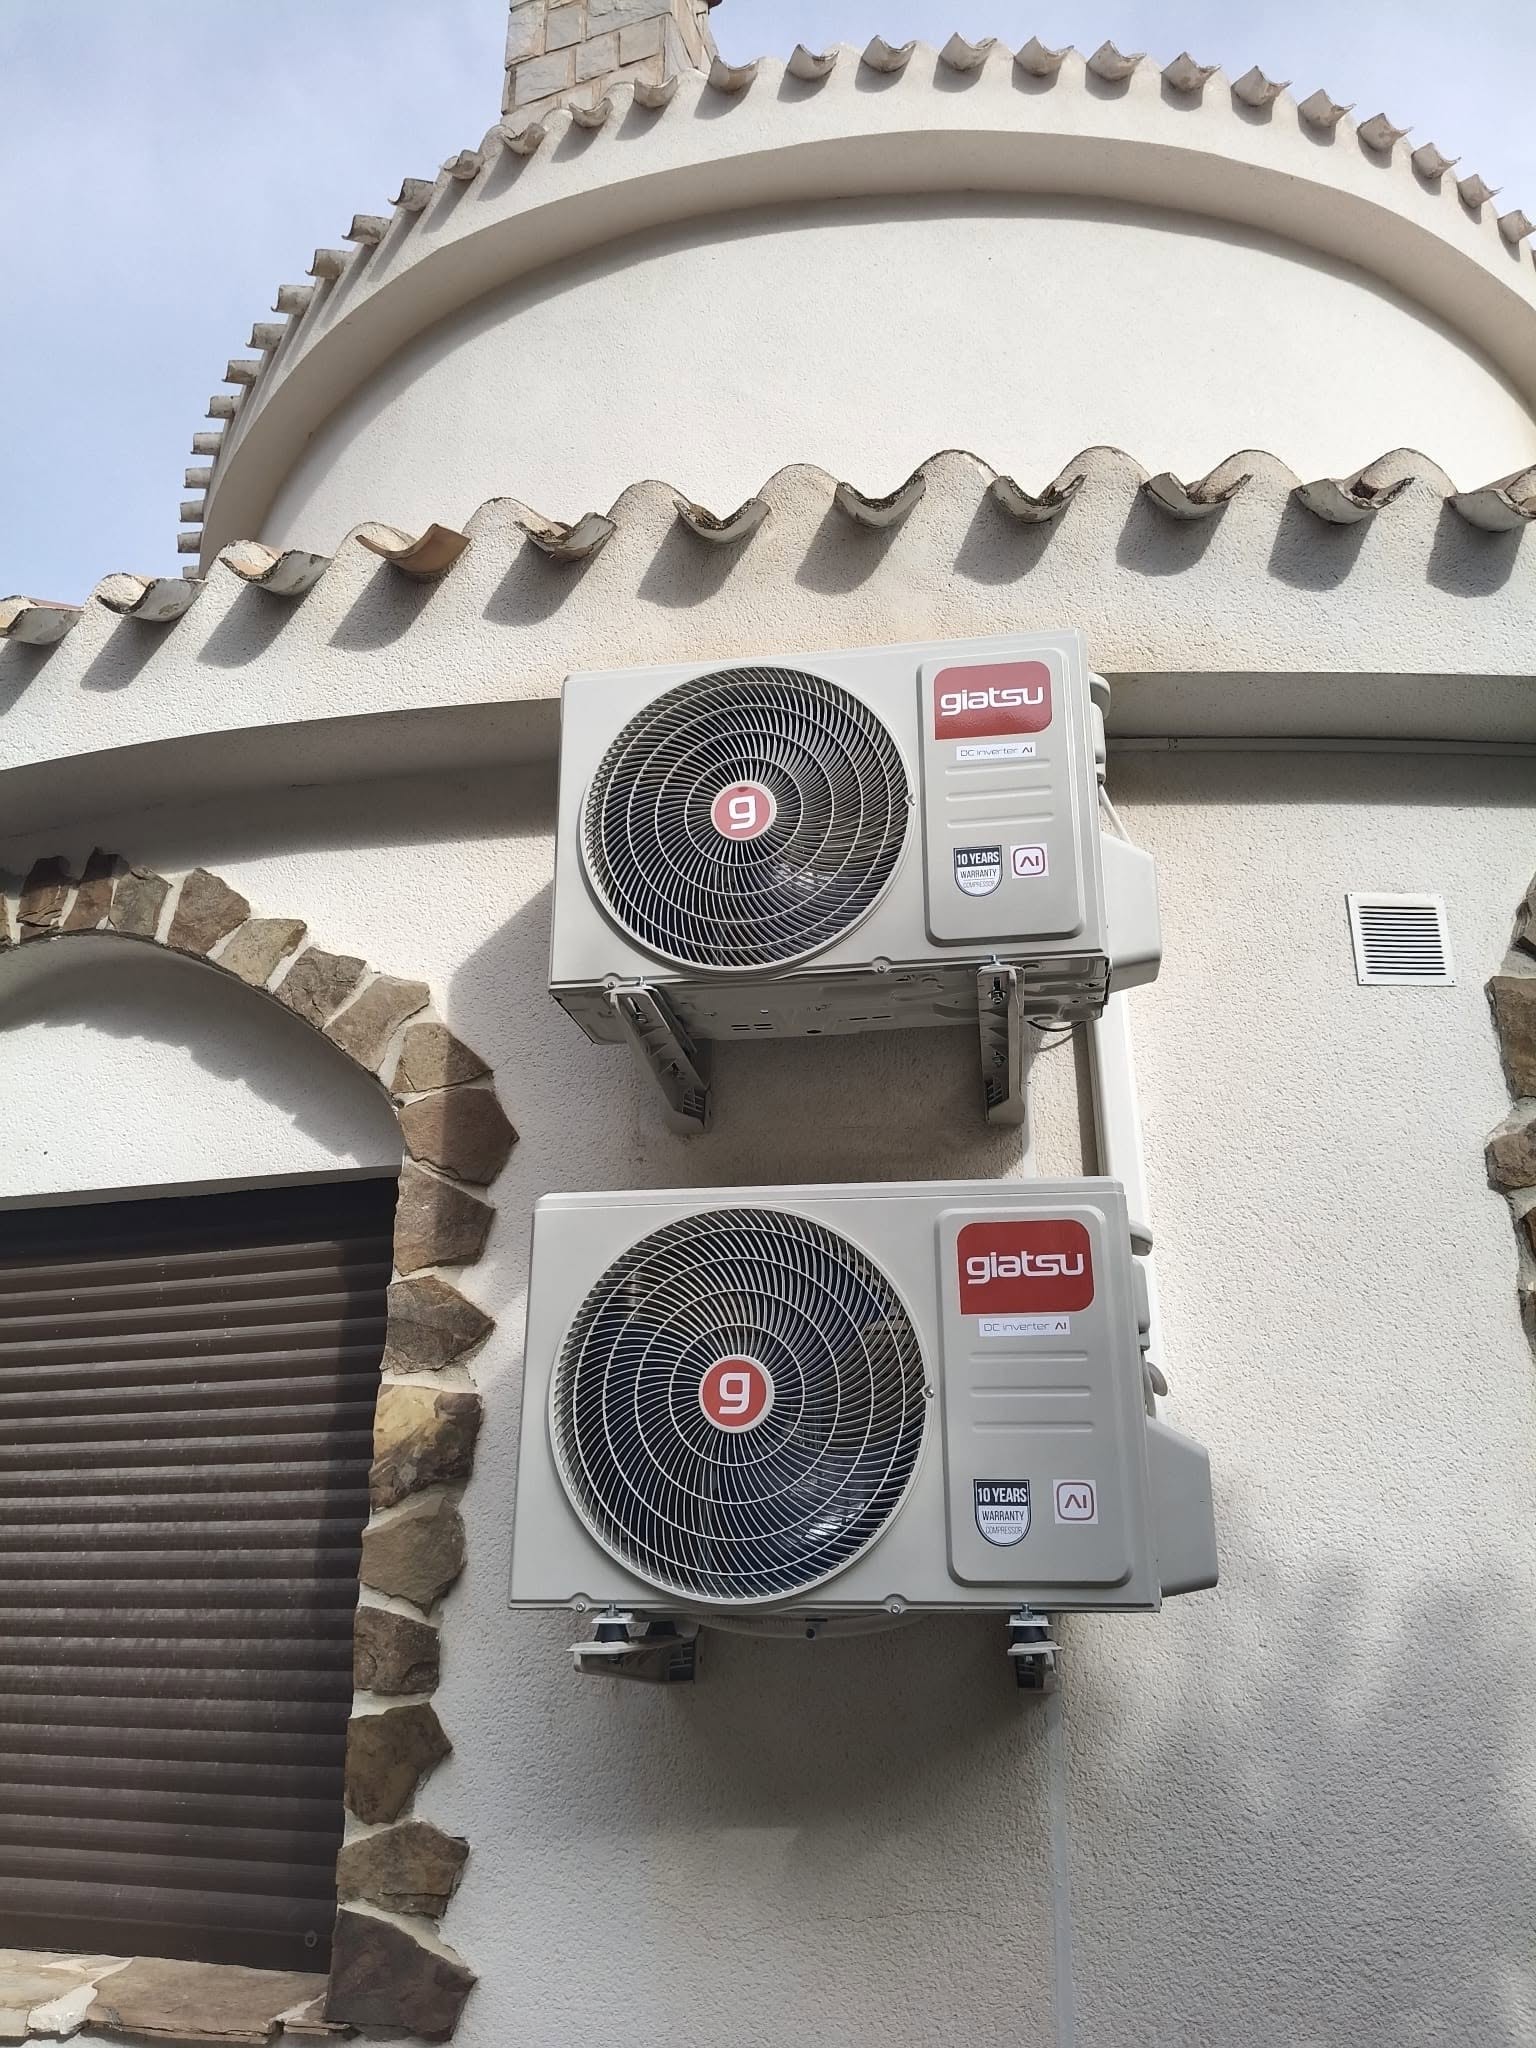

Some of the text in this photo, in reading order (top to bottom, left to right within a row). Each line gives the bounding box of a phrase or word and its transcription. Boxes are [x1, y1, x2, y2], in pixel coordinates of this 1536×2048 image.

[940, 686, 1044, 716] giatsu
[976, 746, 1018, 756] inverter
[956, 852, 999, 866] 10 YEARS
[960, 868, 997, 879] WARRANTY
[966, 1250, 1084, 1285] giatsu
[983, 1321, 1067, 1332] DC inverter AI
[977, 1487, 1027, 1503] 10 YEARS
[982, 1510, 1024, 1521] WARRANTY
[985, 1525, 1023, 1535] COMPRESSOR
